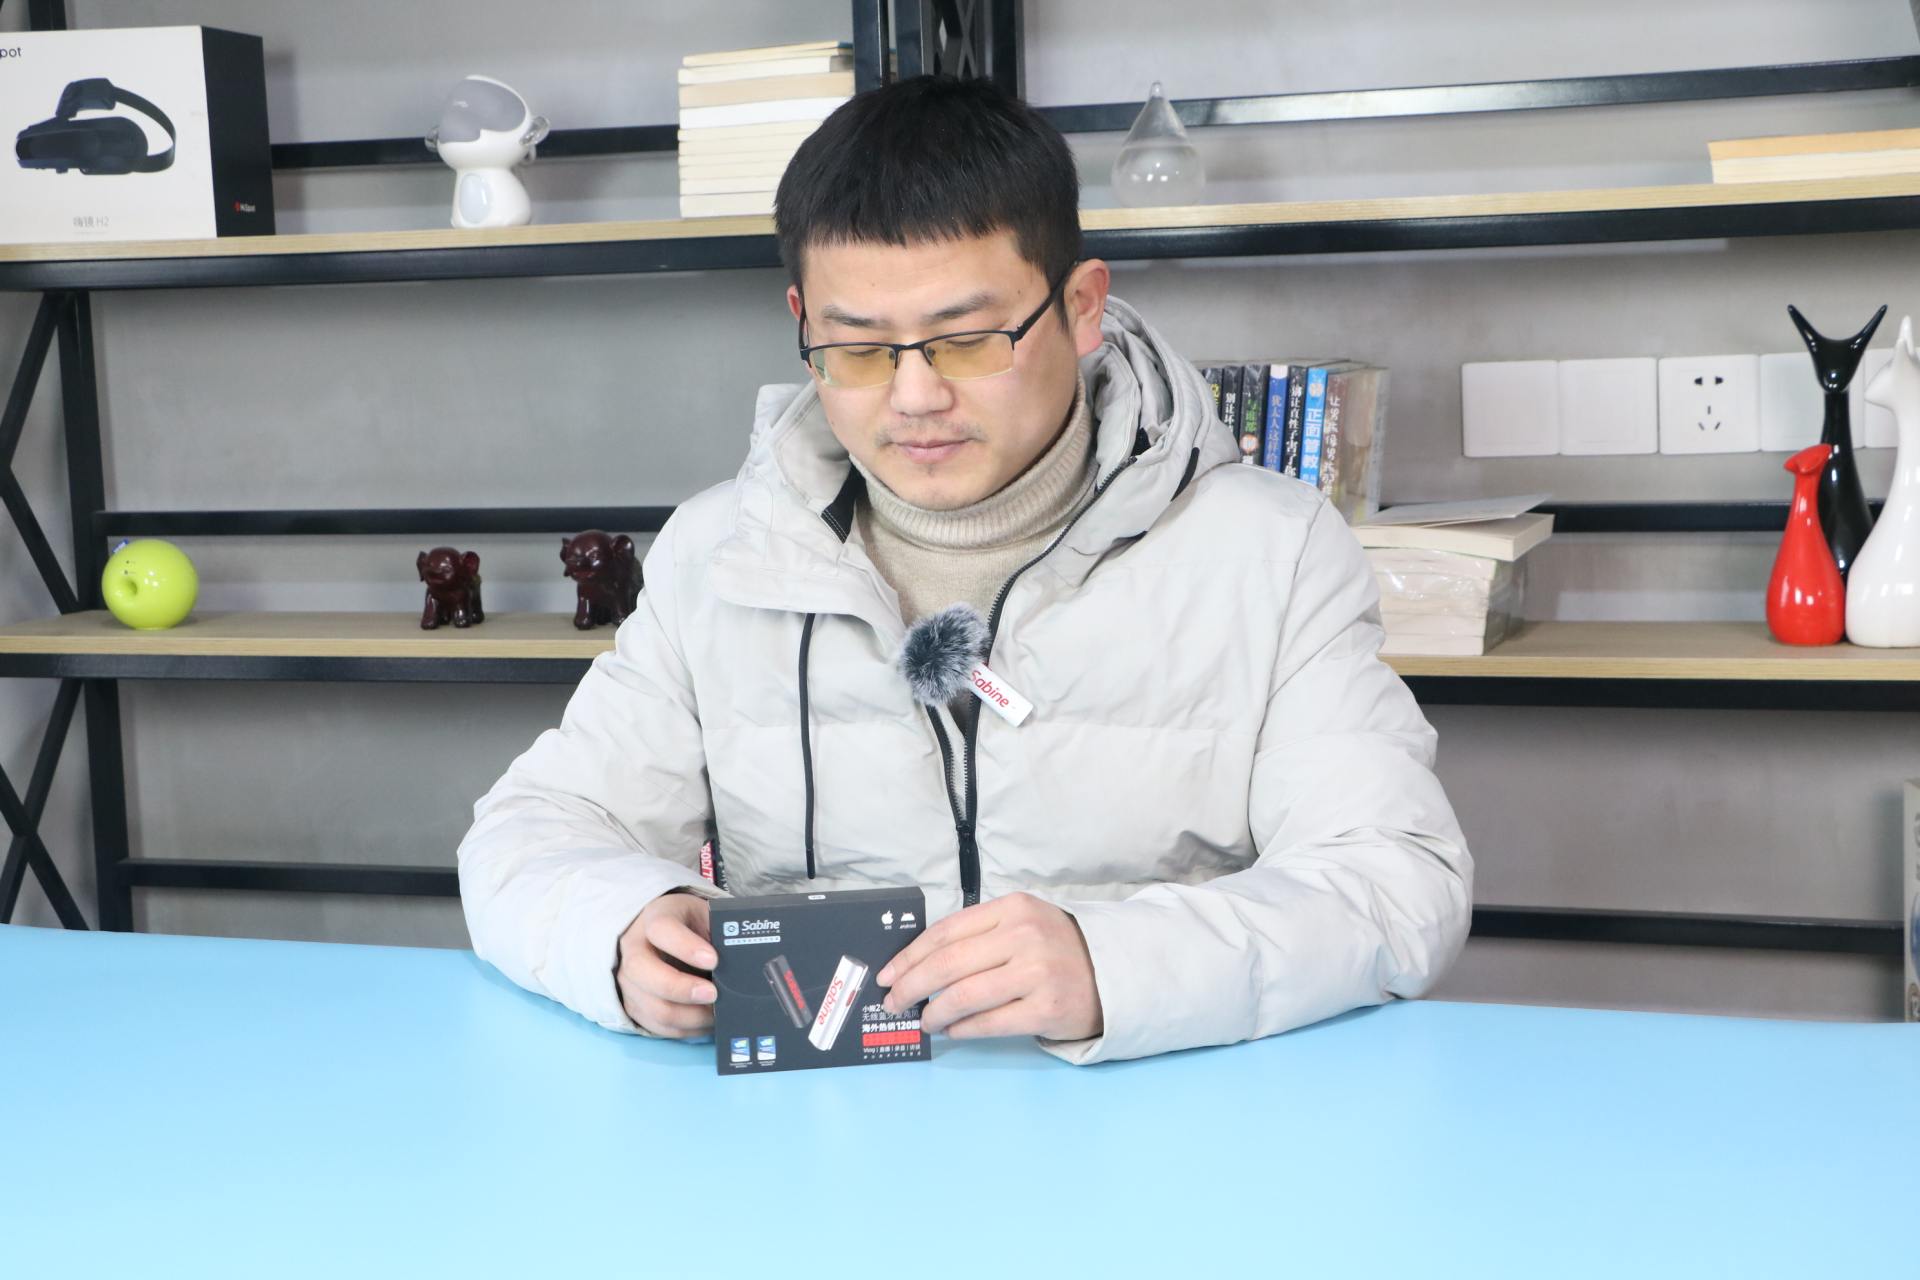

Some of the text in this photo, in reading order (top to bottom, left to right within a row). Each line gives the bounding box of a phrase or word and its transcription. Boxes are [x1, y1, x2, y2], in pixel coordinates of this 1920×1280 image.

[1302, 408, 1323, 469] 正面管教
[970, 669, 1010, 708] Sabine
[741, 919, 780, 931] Sabine
[818, 976, 844, 1025] Sabine
